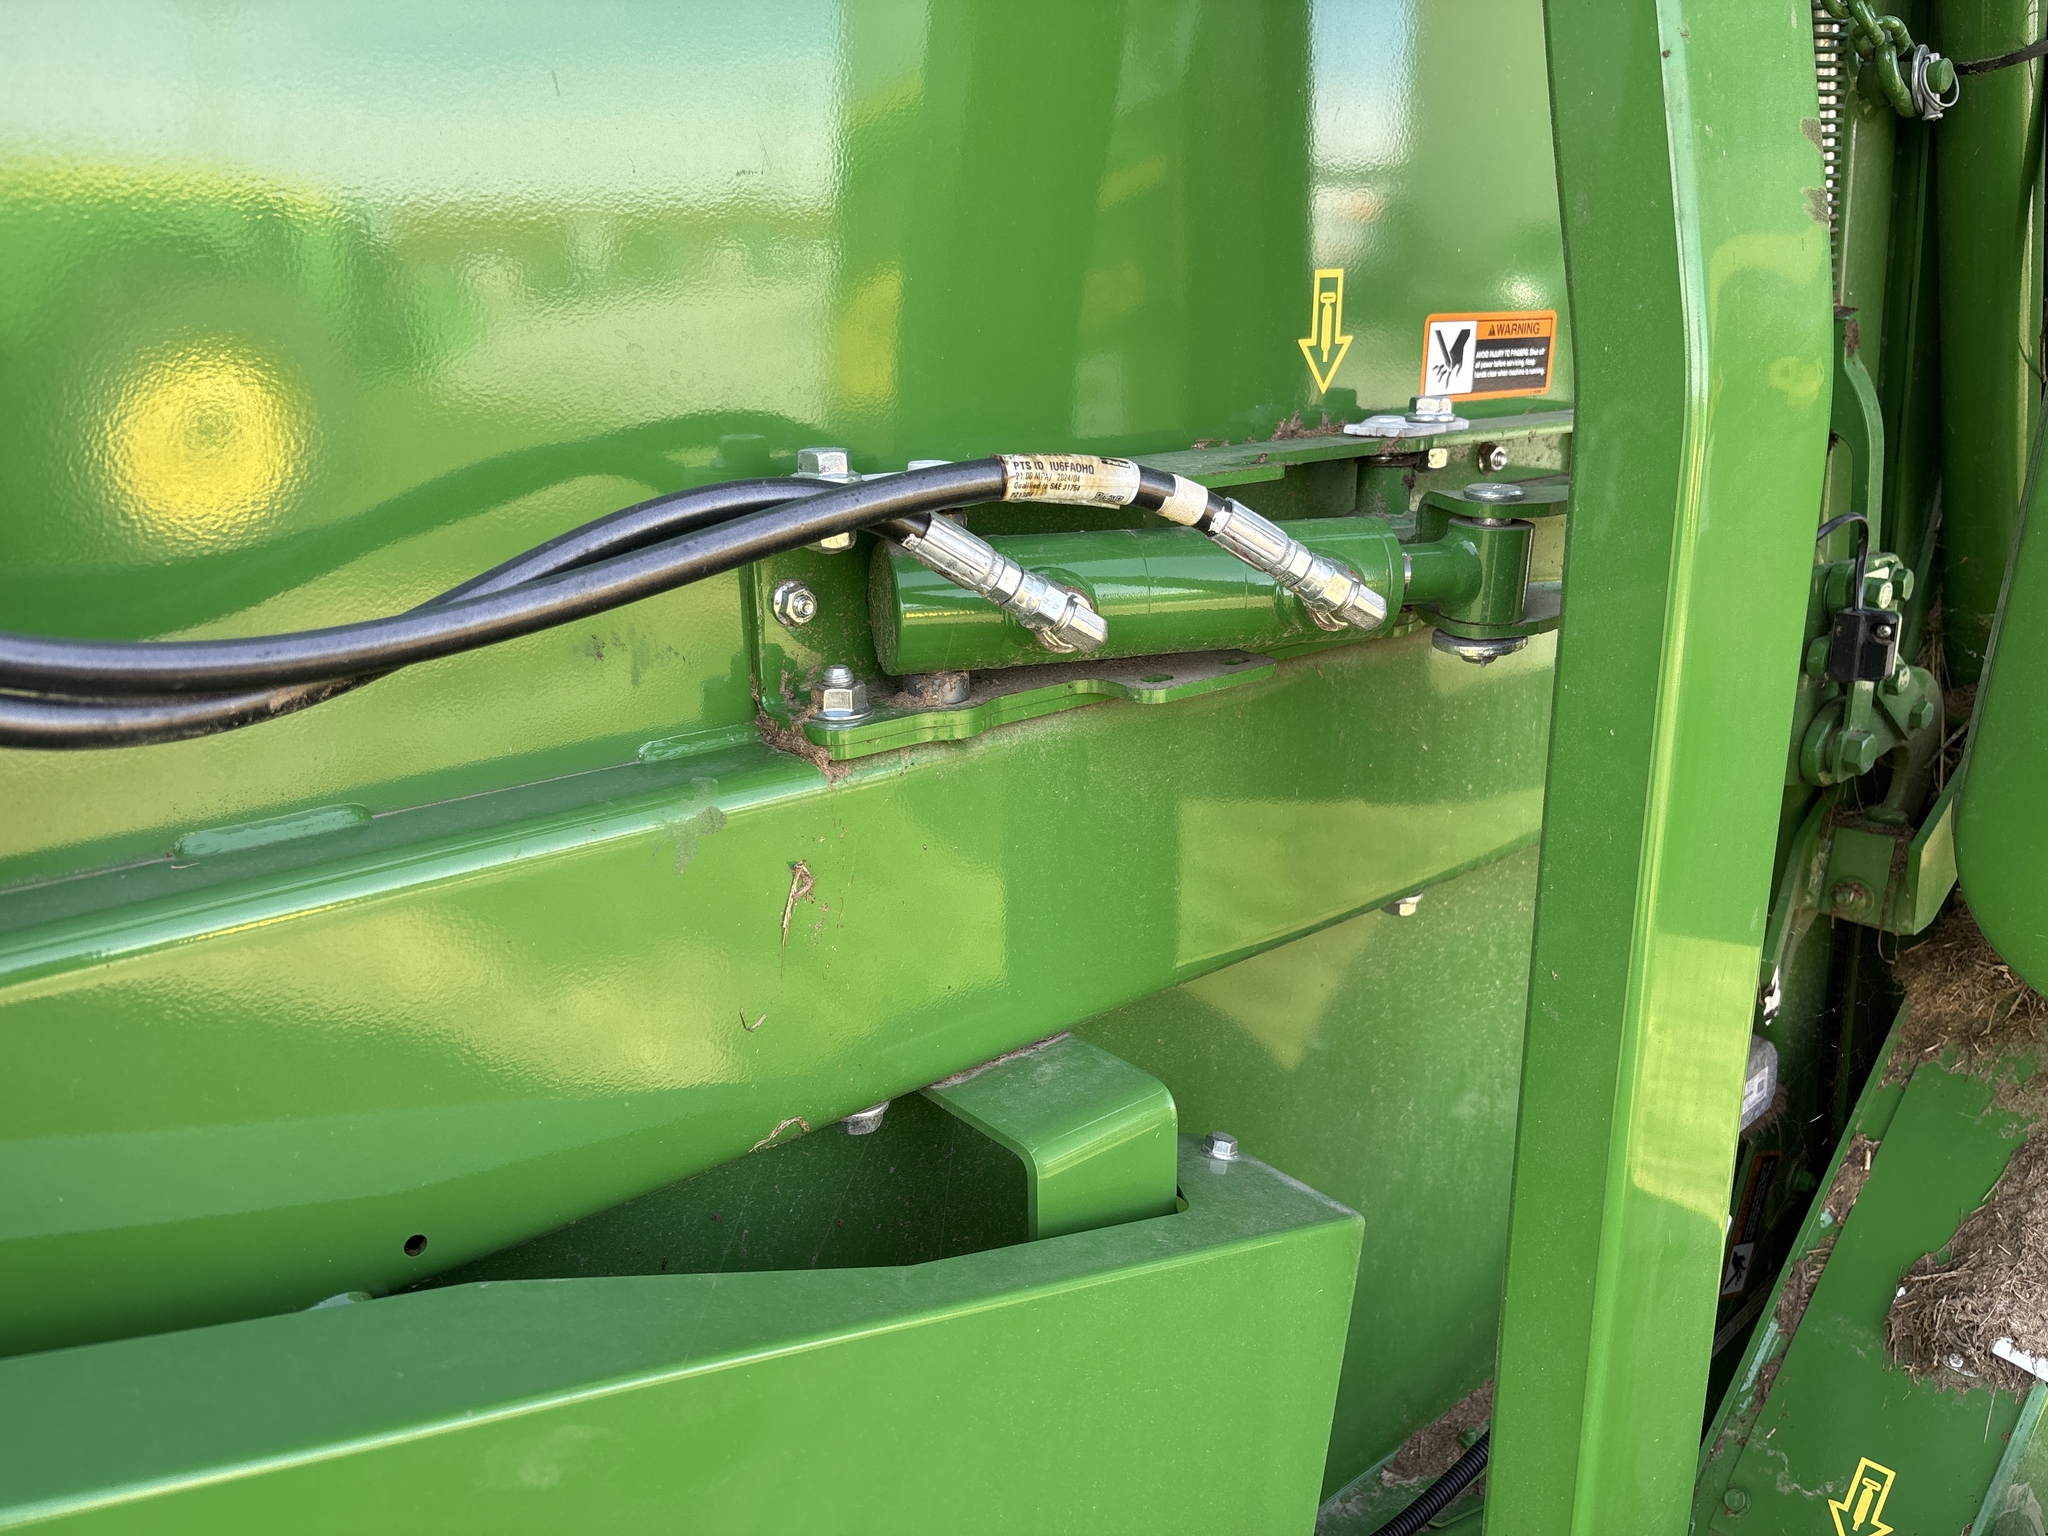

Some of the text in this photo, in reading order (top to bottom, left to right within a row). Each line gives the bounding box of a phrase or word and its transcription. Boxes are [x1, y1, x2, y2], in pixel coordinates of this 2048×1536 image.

[1497, 322, 1540, 336] WARNING
[1481, 361, 1493, 370] power
[1494, 359, 1506, 368] before
[1013, 461, 1032, 471] PTS
[1034, 461, 1044, 471] ID
[1013, 481, 1081, 492] Qualified to SAE J1754
